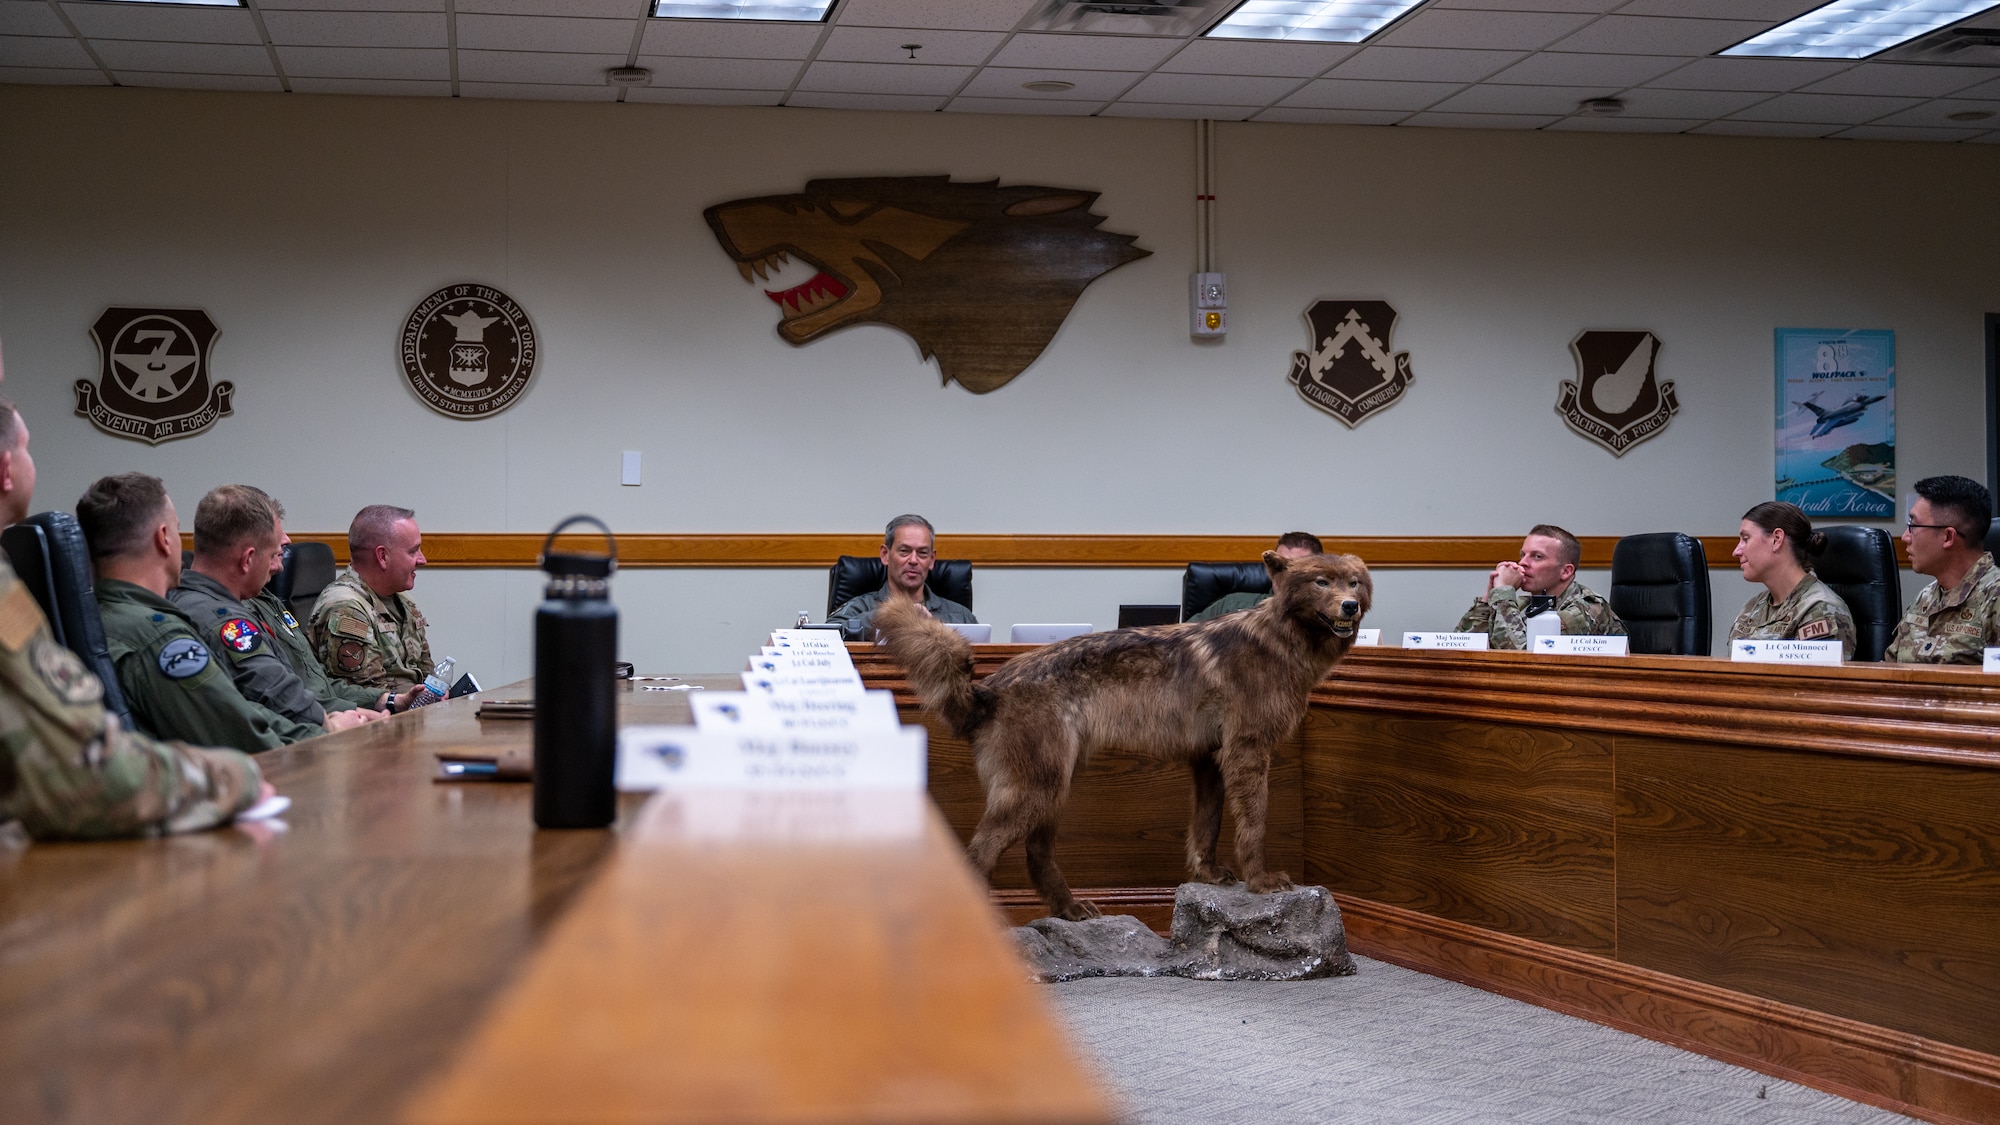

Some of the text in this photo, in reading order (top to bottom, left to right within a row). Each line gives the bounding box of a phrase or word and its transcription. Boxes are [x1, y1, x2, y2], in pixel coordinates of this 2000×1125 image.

[404, 286, 534, 368] DEPARTMENT OF THE AIR FORCE
[1812, 370, 1857, 379] WOLFPACK
[413, 375, 525, 413] UNITED STATES OF AMERICA
[1303, 382, 1401, 416] ATTAQUEZ ET CONQUEREZ
[91, 405, 217, 438] SEVENTH AIR FORCE
[1567, 407, 1669, 448] PACIFIC AIR FORCES
[1785, 489, 1888, 512] South Korea
[1803, 622, 1825, 637] FM
[1792, 643, 1828, 651] Minnocci
